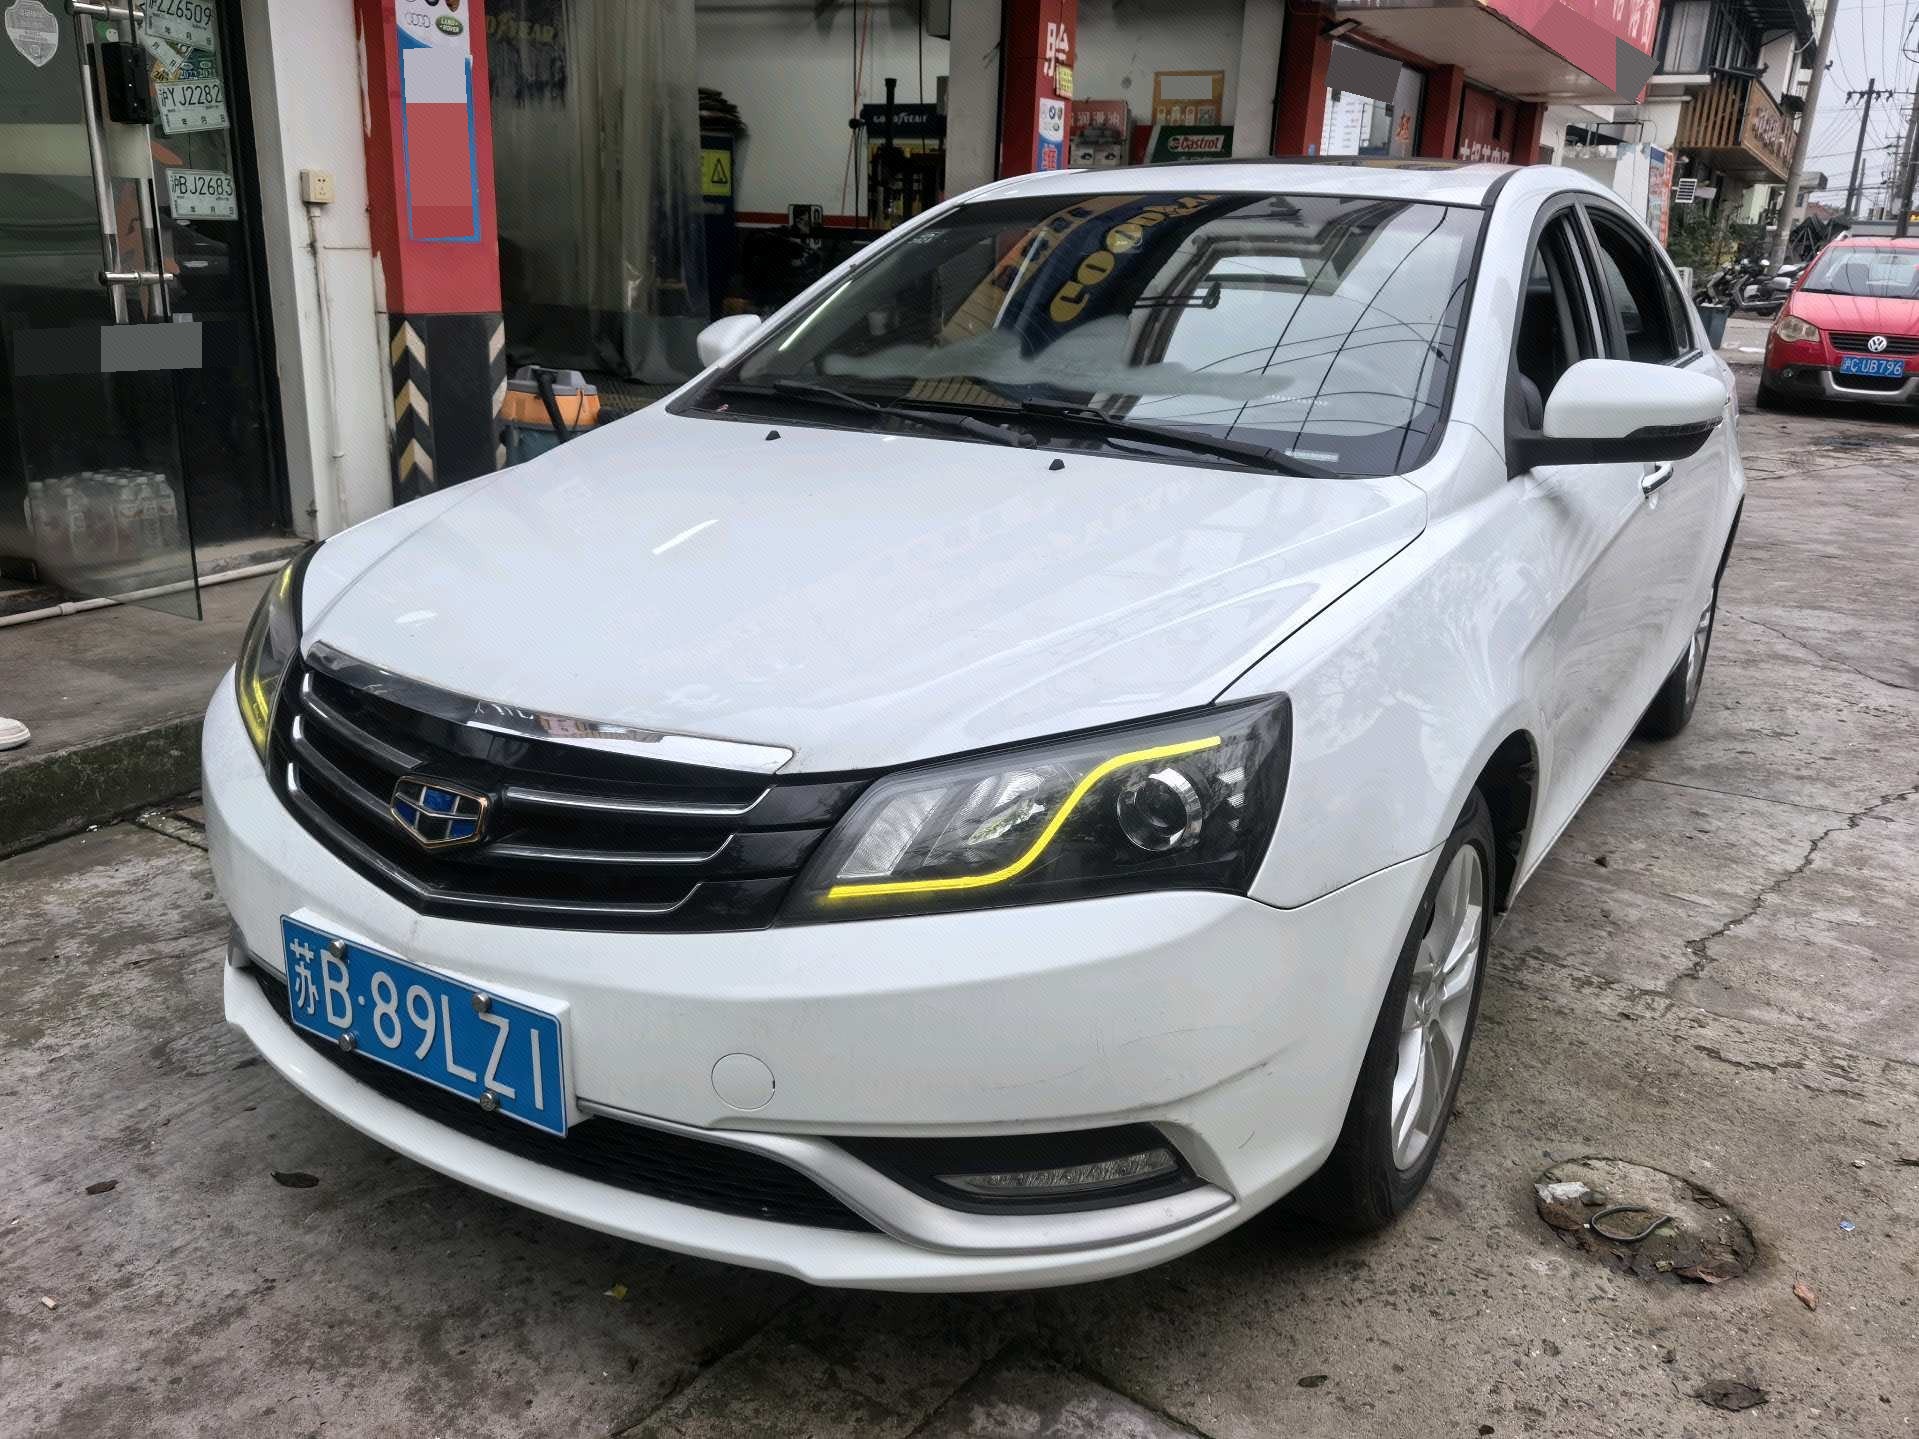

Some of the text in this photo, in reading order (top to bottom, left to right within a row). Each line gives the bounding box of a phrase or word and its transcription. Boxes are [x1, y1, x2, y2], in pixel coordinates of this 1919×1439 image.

[1044, 21, 1069, 77] 胎
[1180, 136, 1220, 150] Castrol
[170, 175, 233, 196] 沪BJ2683
